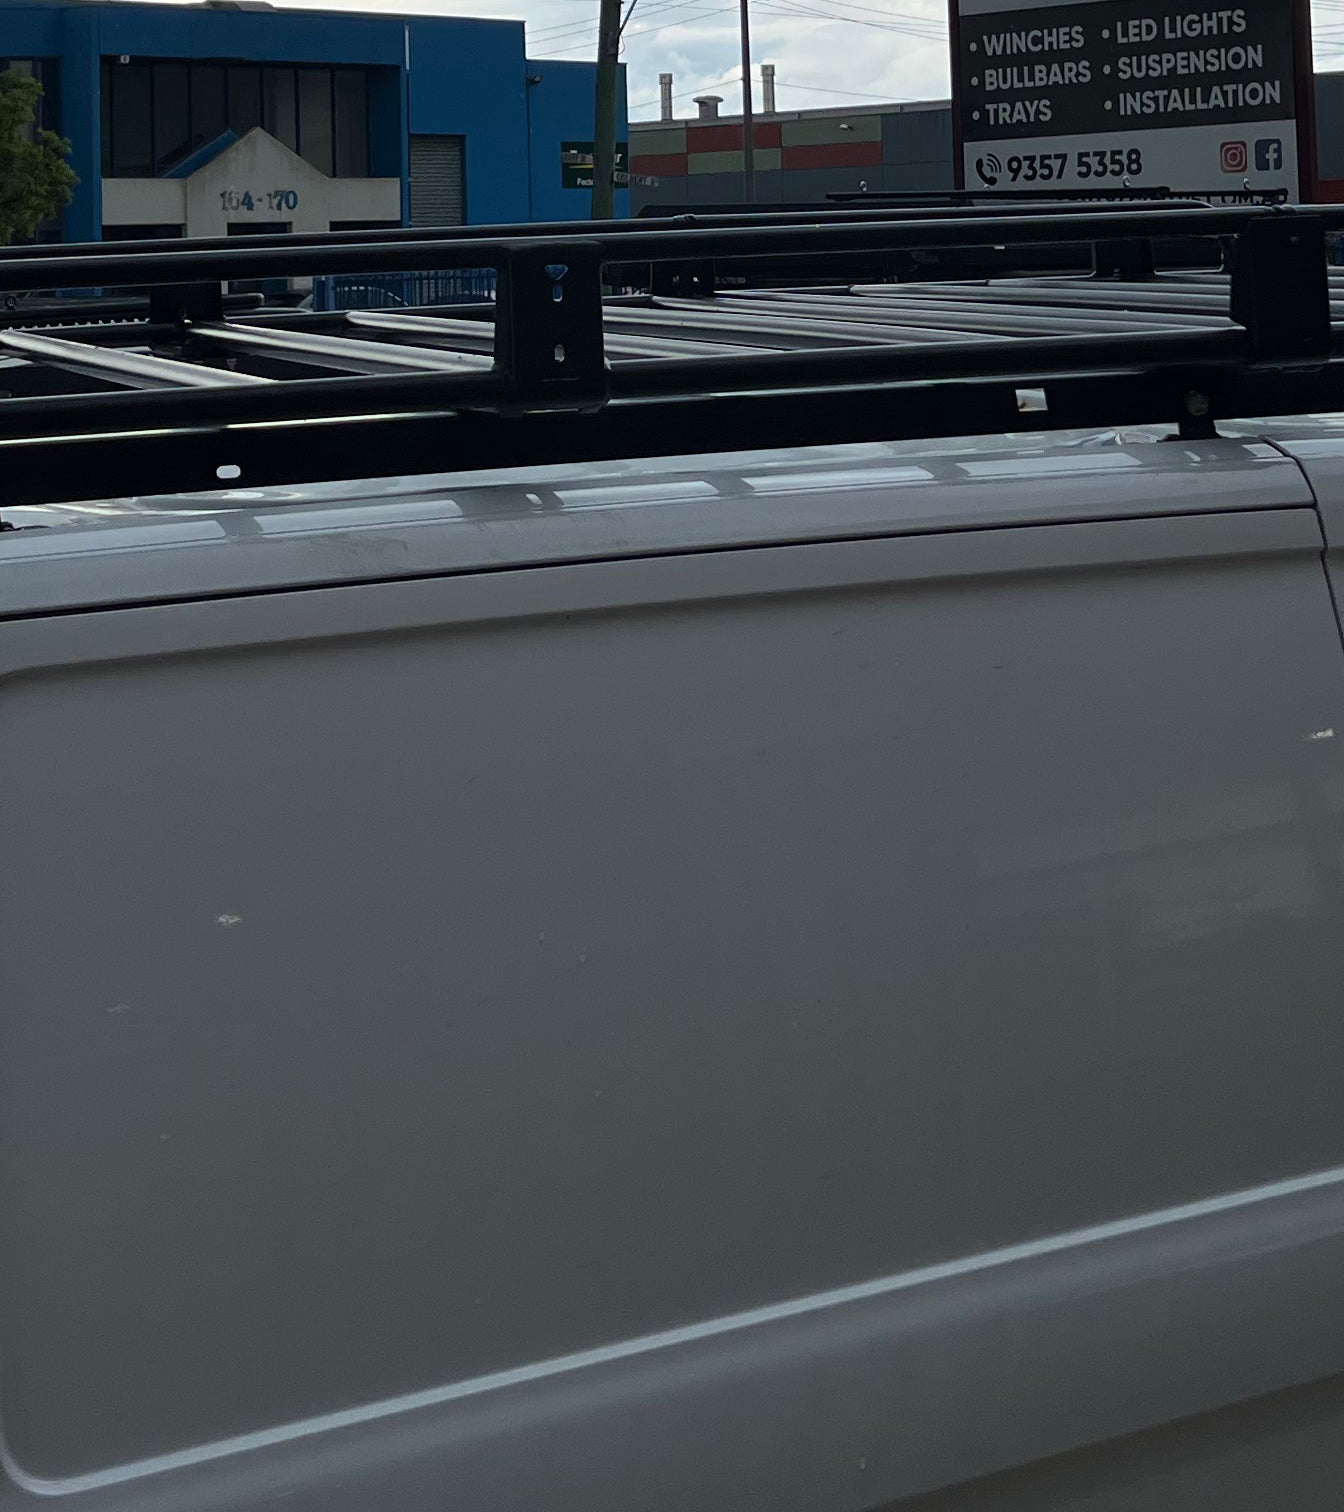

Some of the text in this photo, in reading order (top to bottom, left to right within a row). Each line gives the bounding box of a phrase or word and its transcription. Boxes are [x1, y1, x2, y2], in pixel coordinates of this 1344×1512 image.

[982, 25, 1085, 56] WINCHES
[1116, 9, 1247, 44] LED LIGHTS
[984, 60, 1092, 91] BULLBARS
[1117, 44, 1263, 80] SUSPENSION
[985, 98, 1052, 125] TRAYS
[1119, 80, 1281, 116] INSTALLATION
[1007, 149, 1143, 182] 9357 5358
